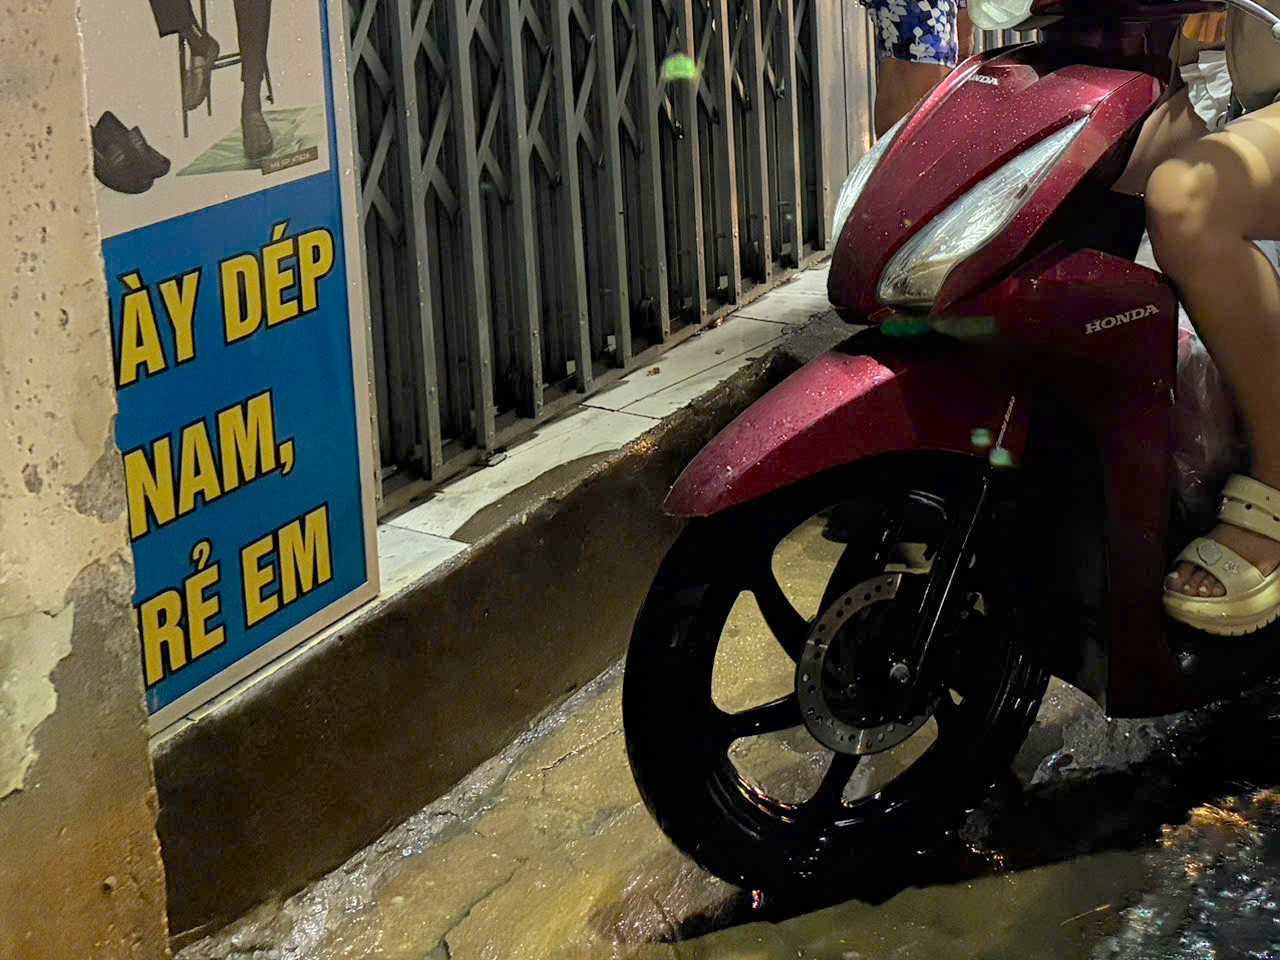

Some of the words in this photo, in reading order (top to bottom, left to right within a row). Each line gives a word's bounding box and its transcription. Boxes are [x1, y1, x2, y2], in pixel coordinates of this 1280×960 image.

[969, 74, 999, 86] NDA
[115, 267, 202, 389] ÀY
[220, 221, 335, 345] DÉP
[1084, 304, 1159, 335] HONDA
[123, 389, 295, 541] NAM,
[133, 541, 226, 689] RẺ
[240, 502, 333, 629] EM
